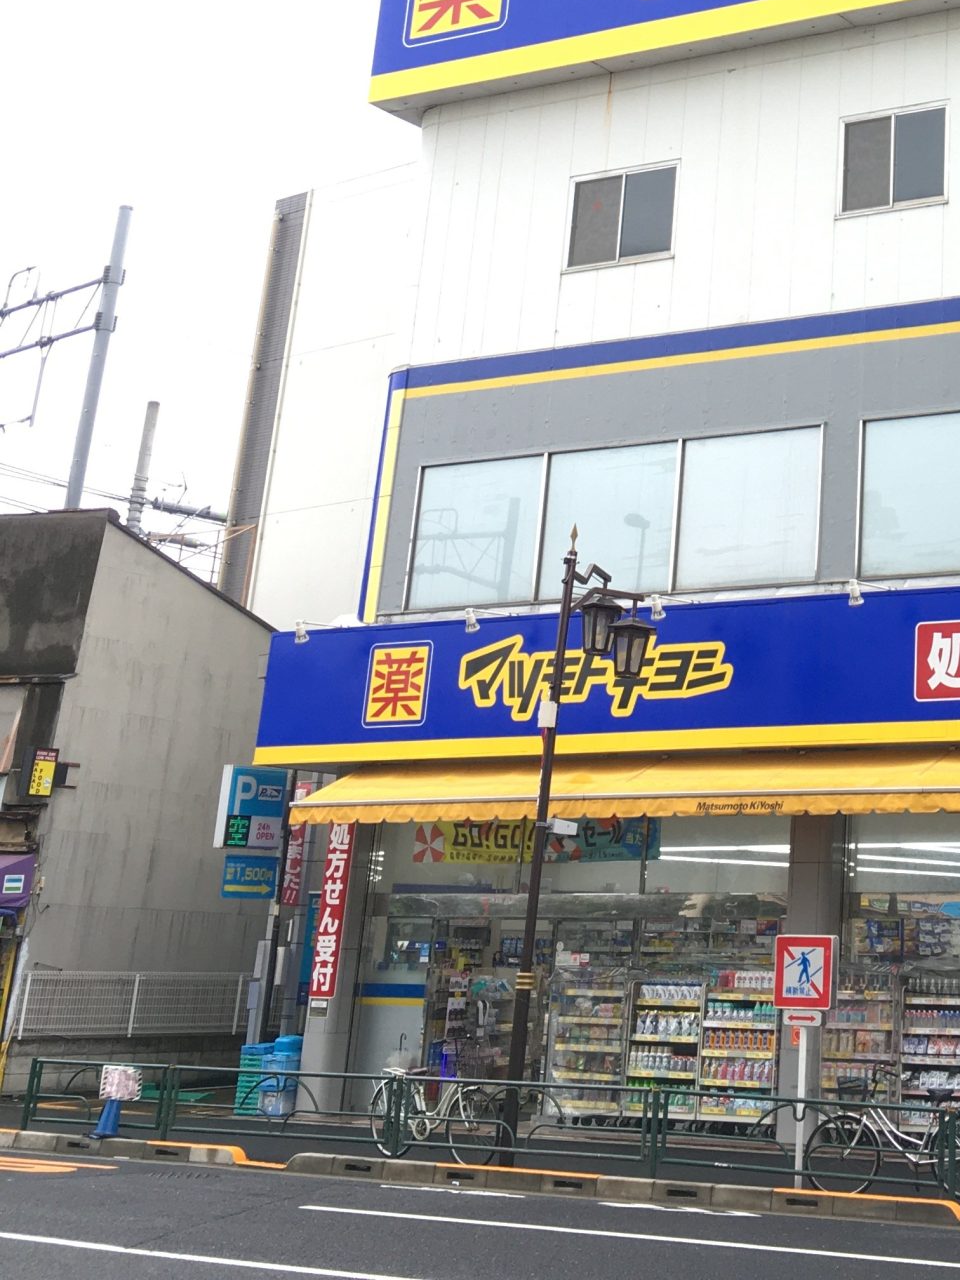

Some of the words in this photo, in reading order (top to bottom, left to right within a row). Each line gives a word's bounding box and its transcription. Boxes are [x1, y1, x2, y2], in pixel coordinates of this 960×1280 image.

[372, 650, 424, 719] 薬
[233, 775, 257, 816] P
[696, 802, 748, 811] Matsumoto
[229, 817, 248, 846] 空
[255, 832, 275, 841] OPEN
[257, 823, 271, 832] 24h
[312, 823, 350, 993] 処方せん受付
